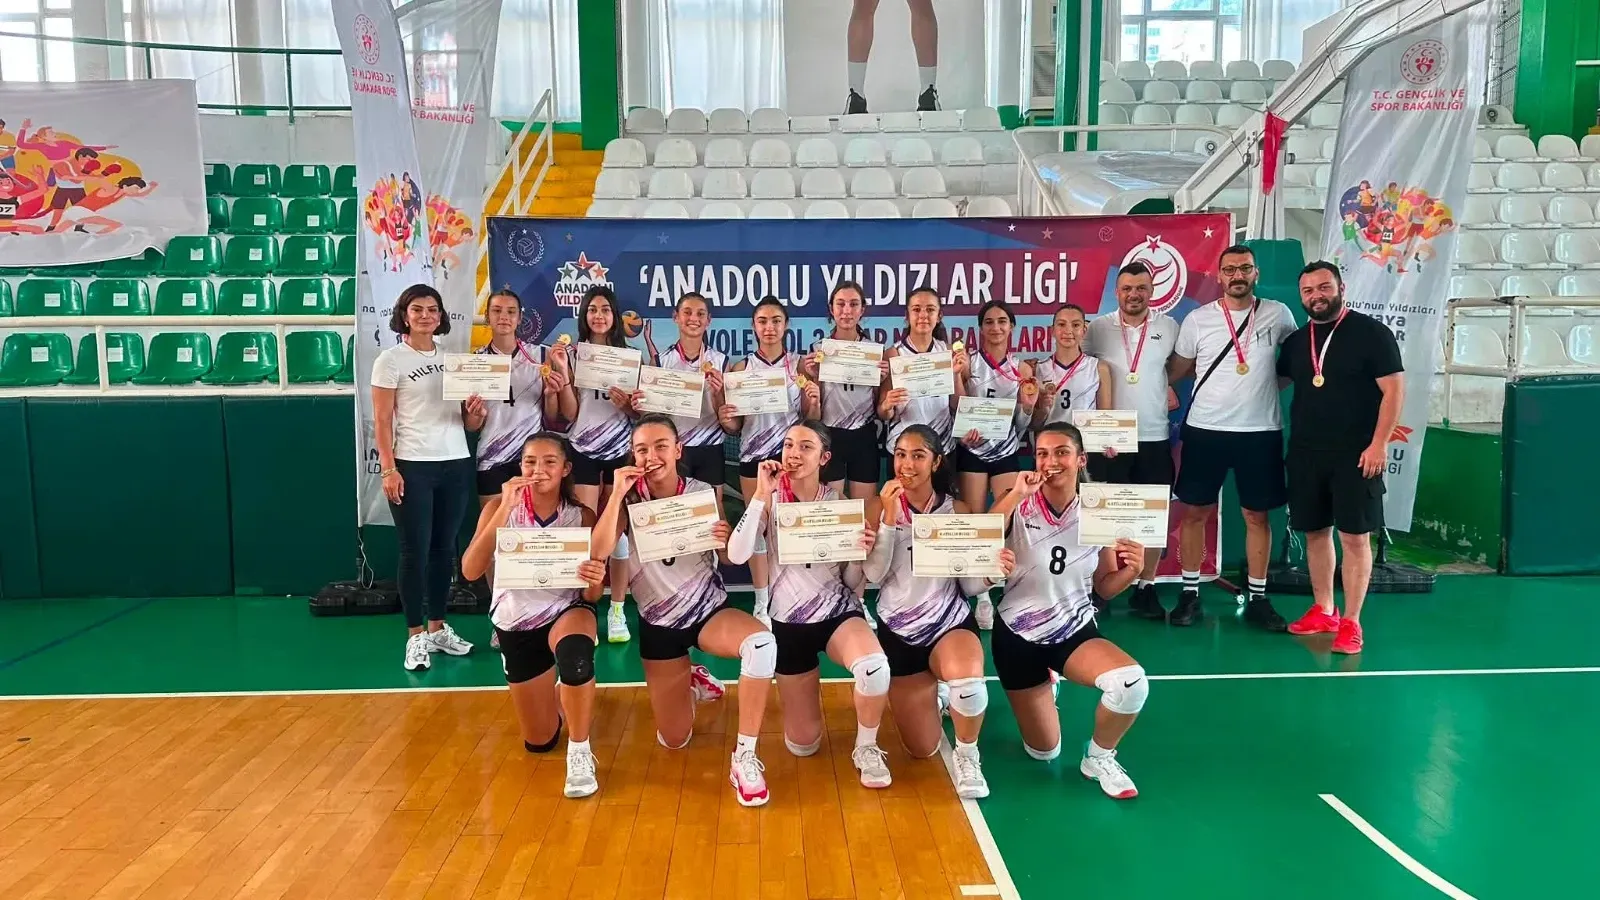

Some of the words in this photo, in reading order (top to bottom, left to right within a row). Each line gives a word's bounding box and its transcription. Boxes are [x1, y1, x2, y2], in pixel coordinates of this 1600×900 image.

[1450, 88, 1465, 98] VE
[1370, 102, 1400, 112] SPOR
[1402, 100, 1464, 112] BAKANLIĞI
[419, 110, 475, 125] BAKANLIĞI
[1004, 252, 1078, 304] LİGİ'
[703, 329, 808, 356] VOLEOL
[1060, 388, 1071, 409] 3
[1049, 545, 1067, 575] 8
